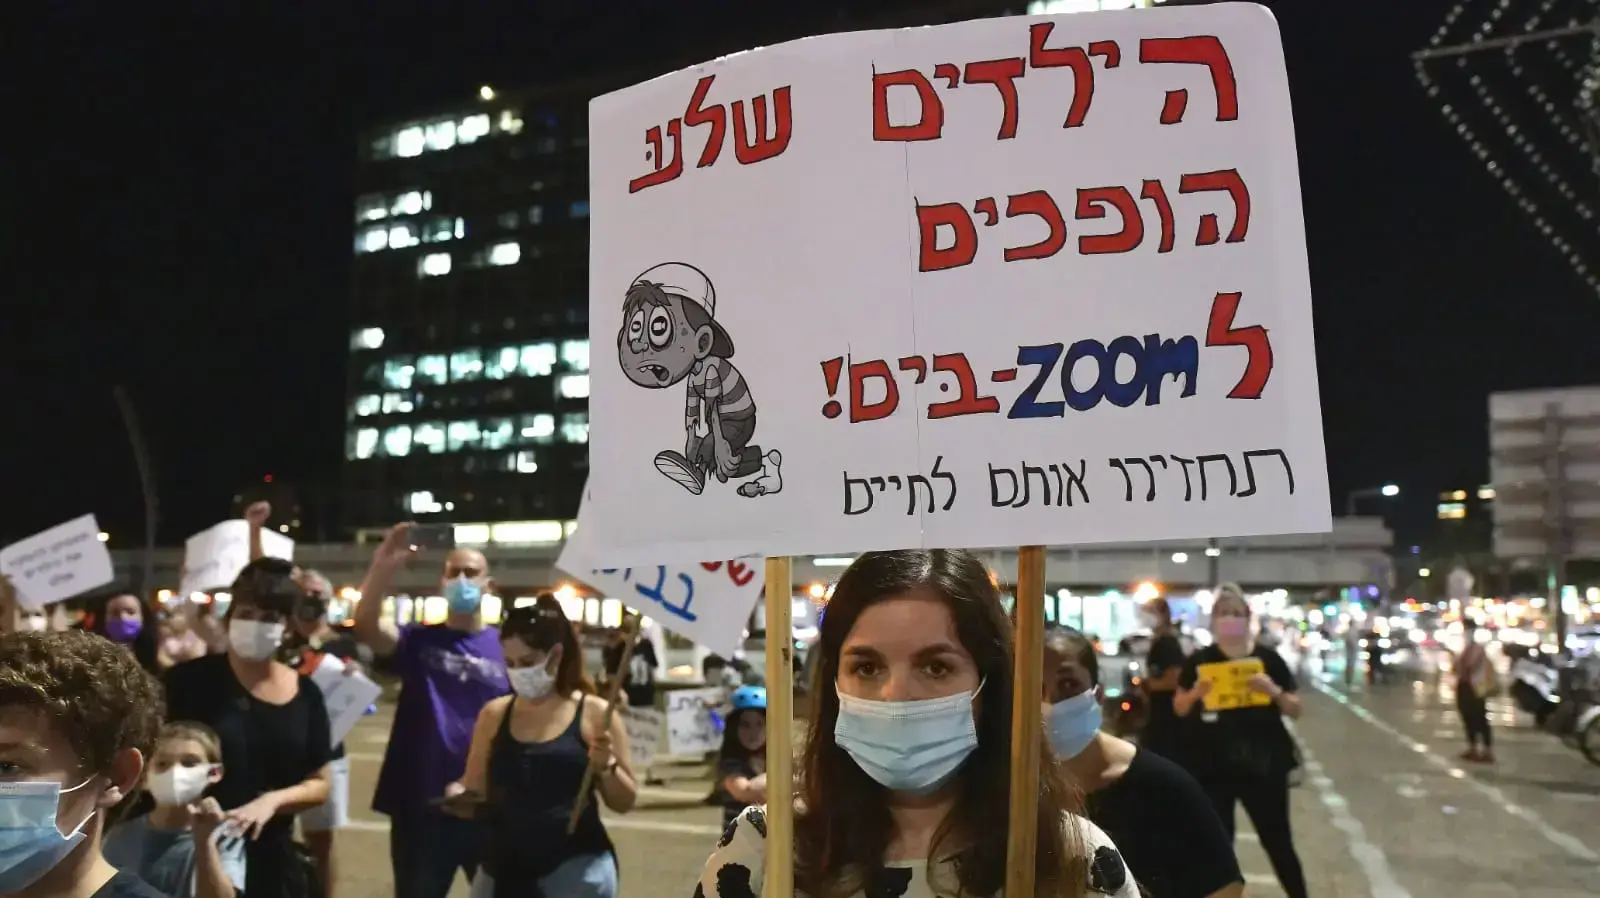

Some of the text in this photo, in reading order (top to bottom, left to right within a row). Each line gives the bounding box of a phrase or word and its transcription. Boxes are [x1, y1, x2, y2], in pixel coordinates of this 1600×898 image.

[871, 21, 1239, 143] הילדים
[913, 167, 1251, 273] הופכים
[843, 448, 1295, 516] תחזירו אותם לחיים
